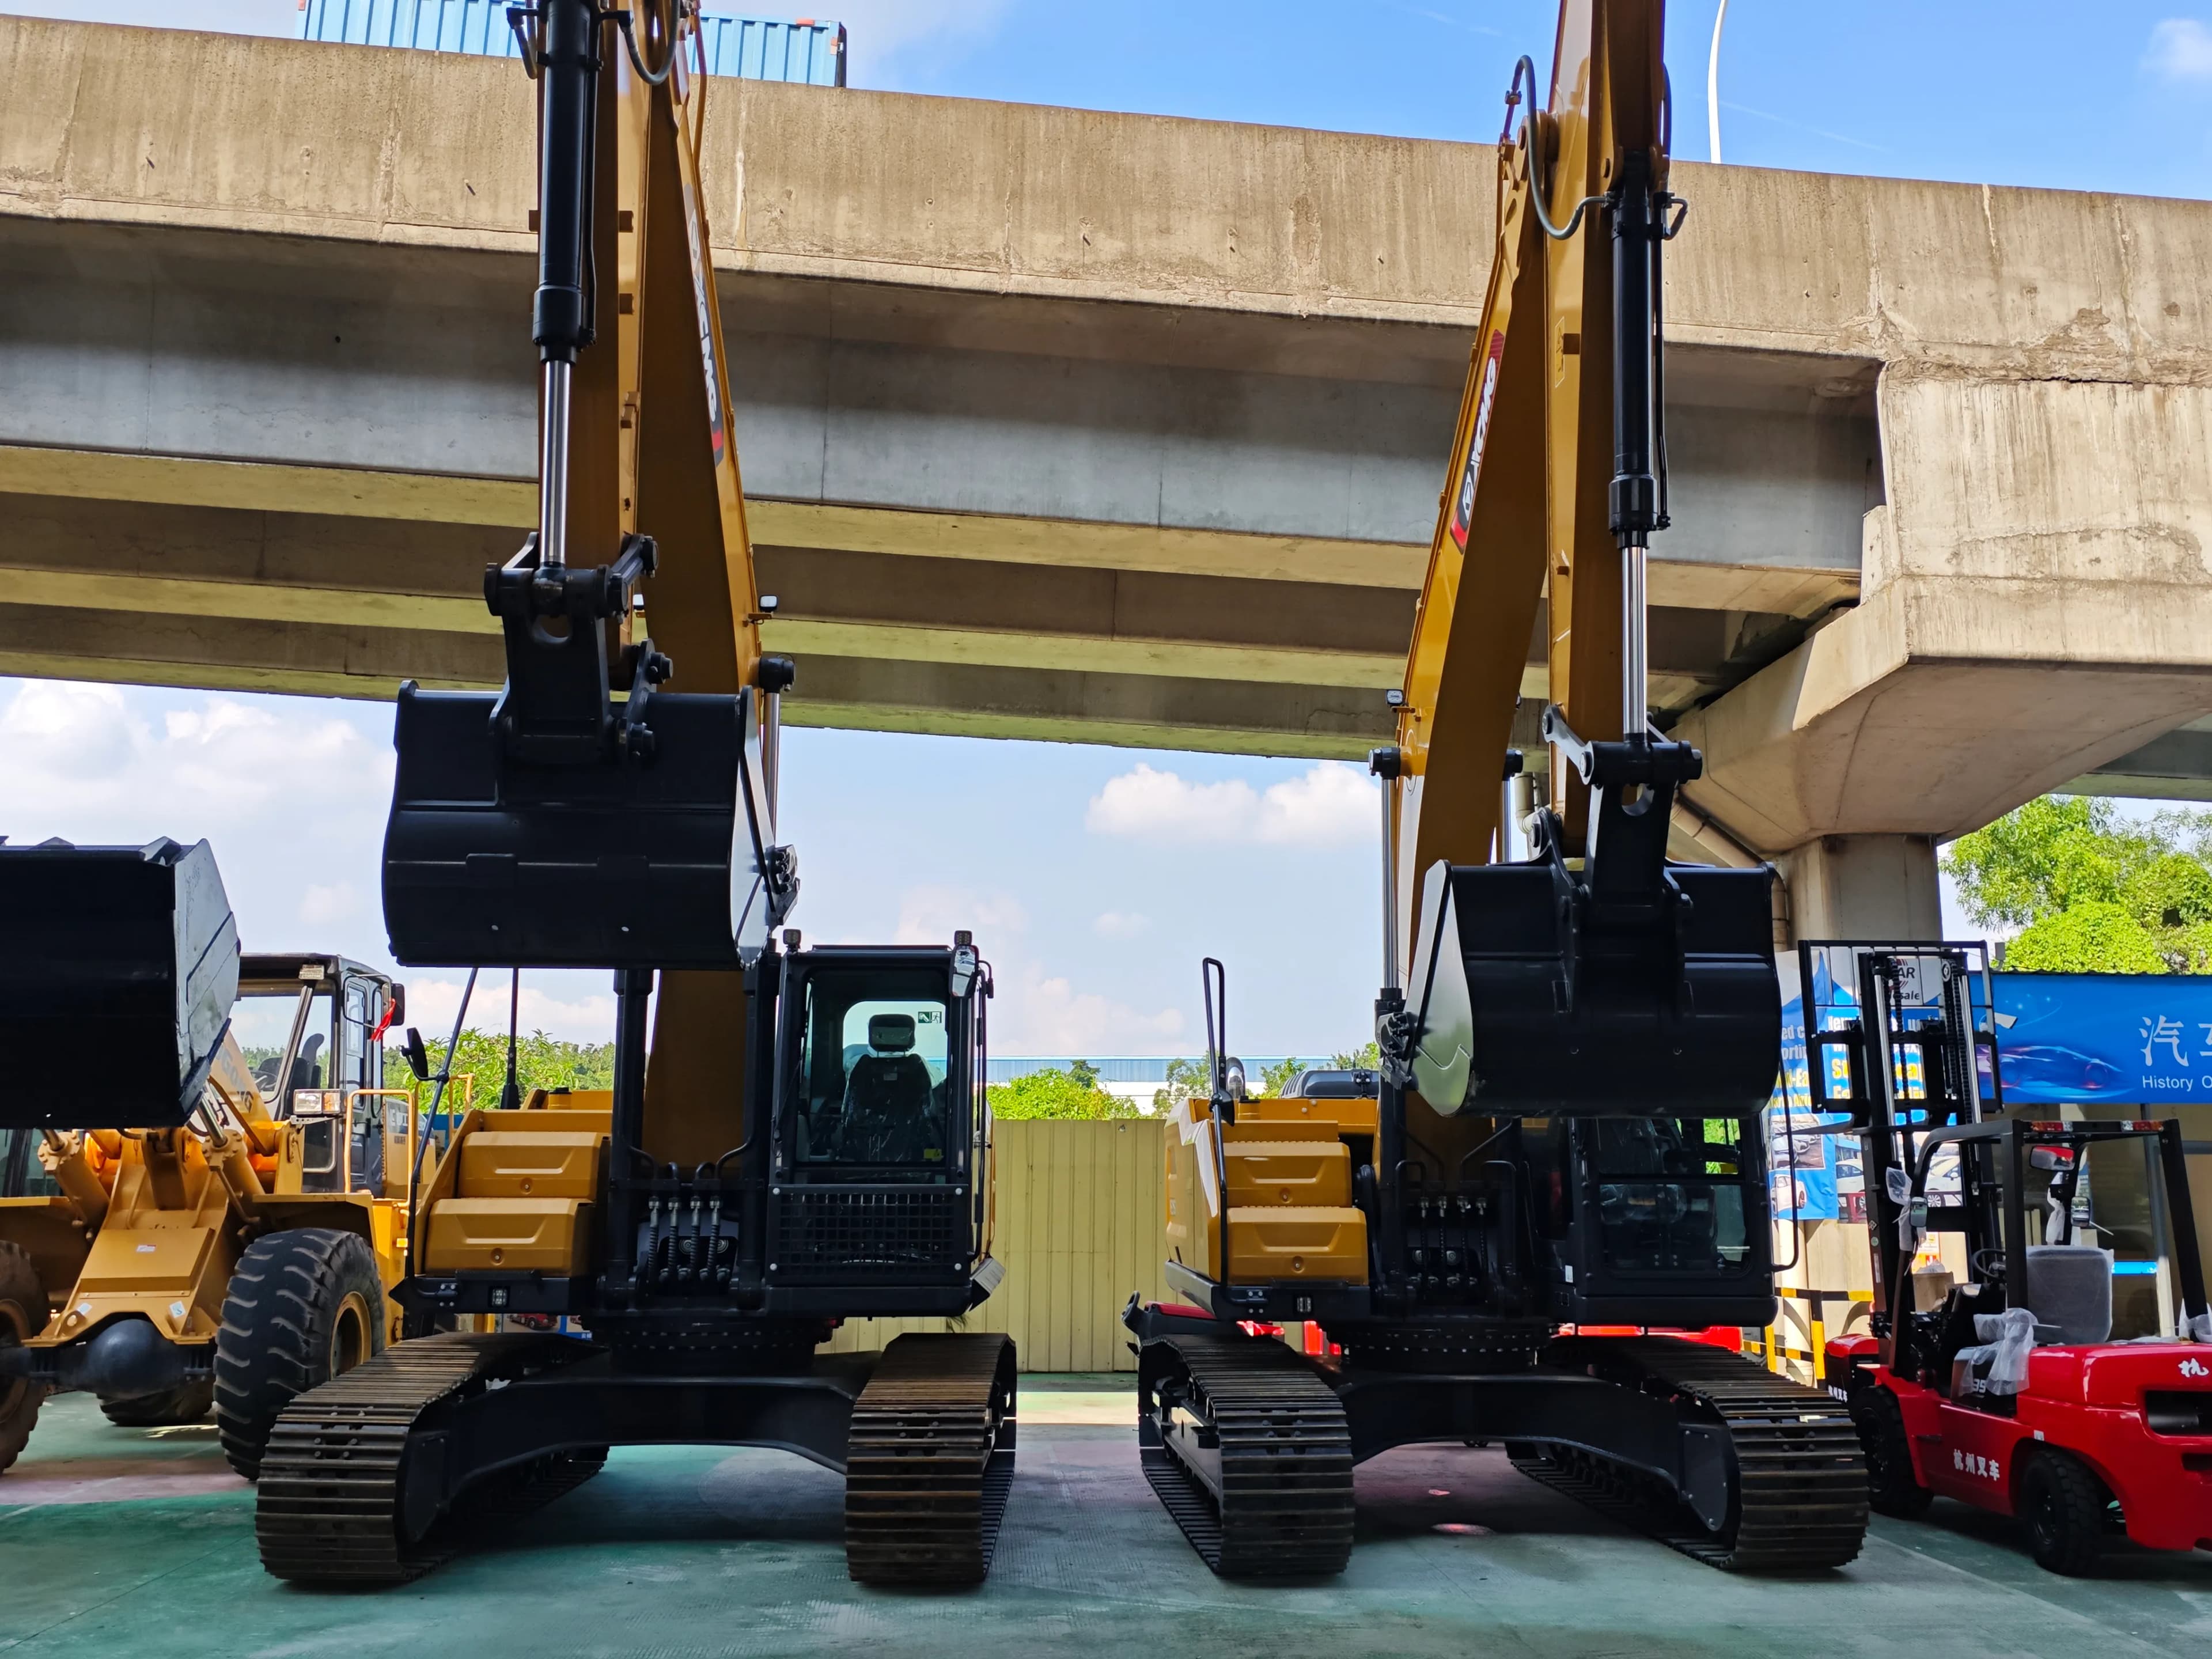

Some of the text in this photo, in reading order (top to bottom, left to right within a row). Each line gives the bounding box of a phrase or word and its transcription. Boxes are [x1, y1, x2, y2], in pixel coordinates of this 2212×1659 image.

[694, 270, 718, 423] XCMG
[1470, 356, 1497, 485] XCMG
[1898, 967, 1915, 979] AR
[2139, 1014, 2212, 1066] 汽
[2142, 1075, 2194, 1092] History
[1953, 1448, 2001, 1482] 杭州叉车
